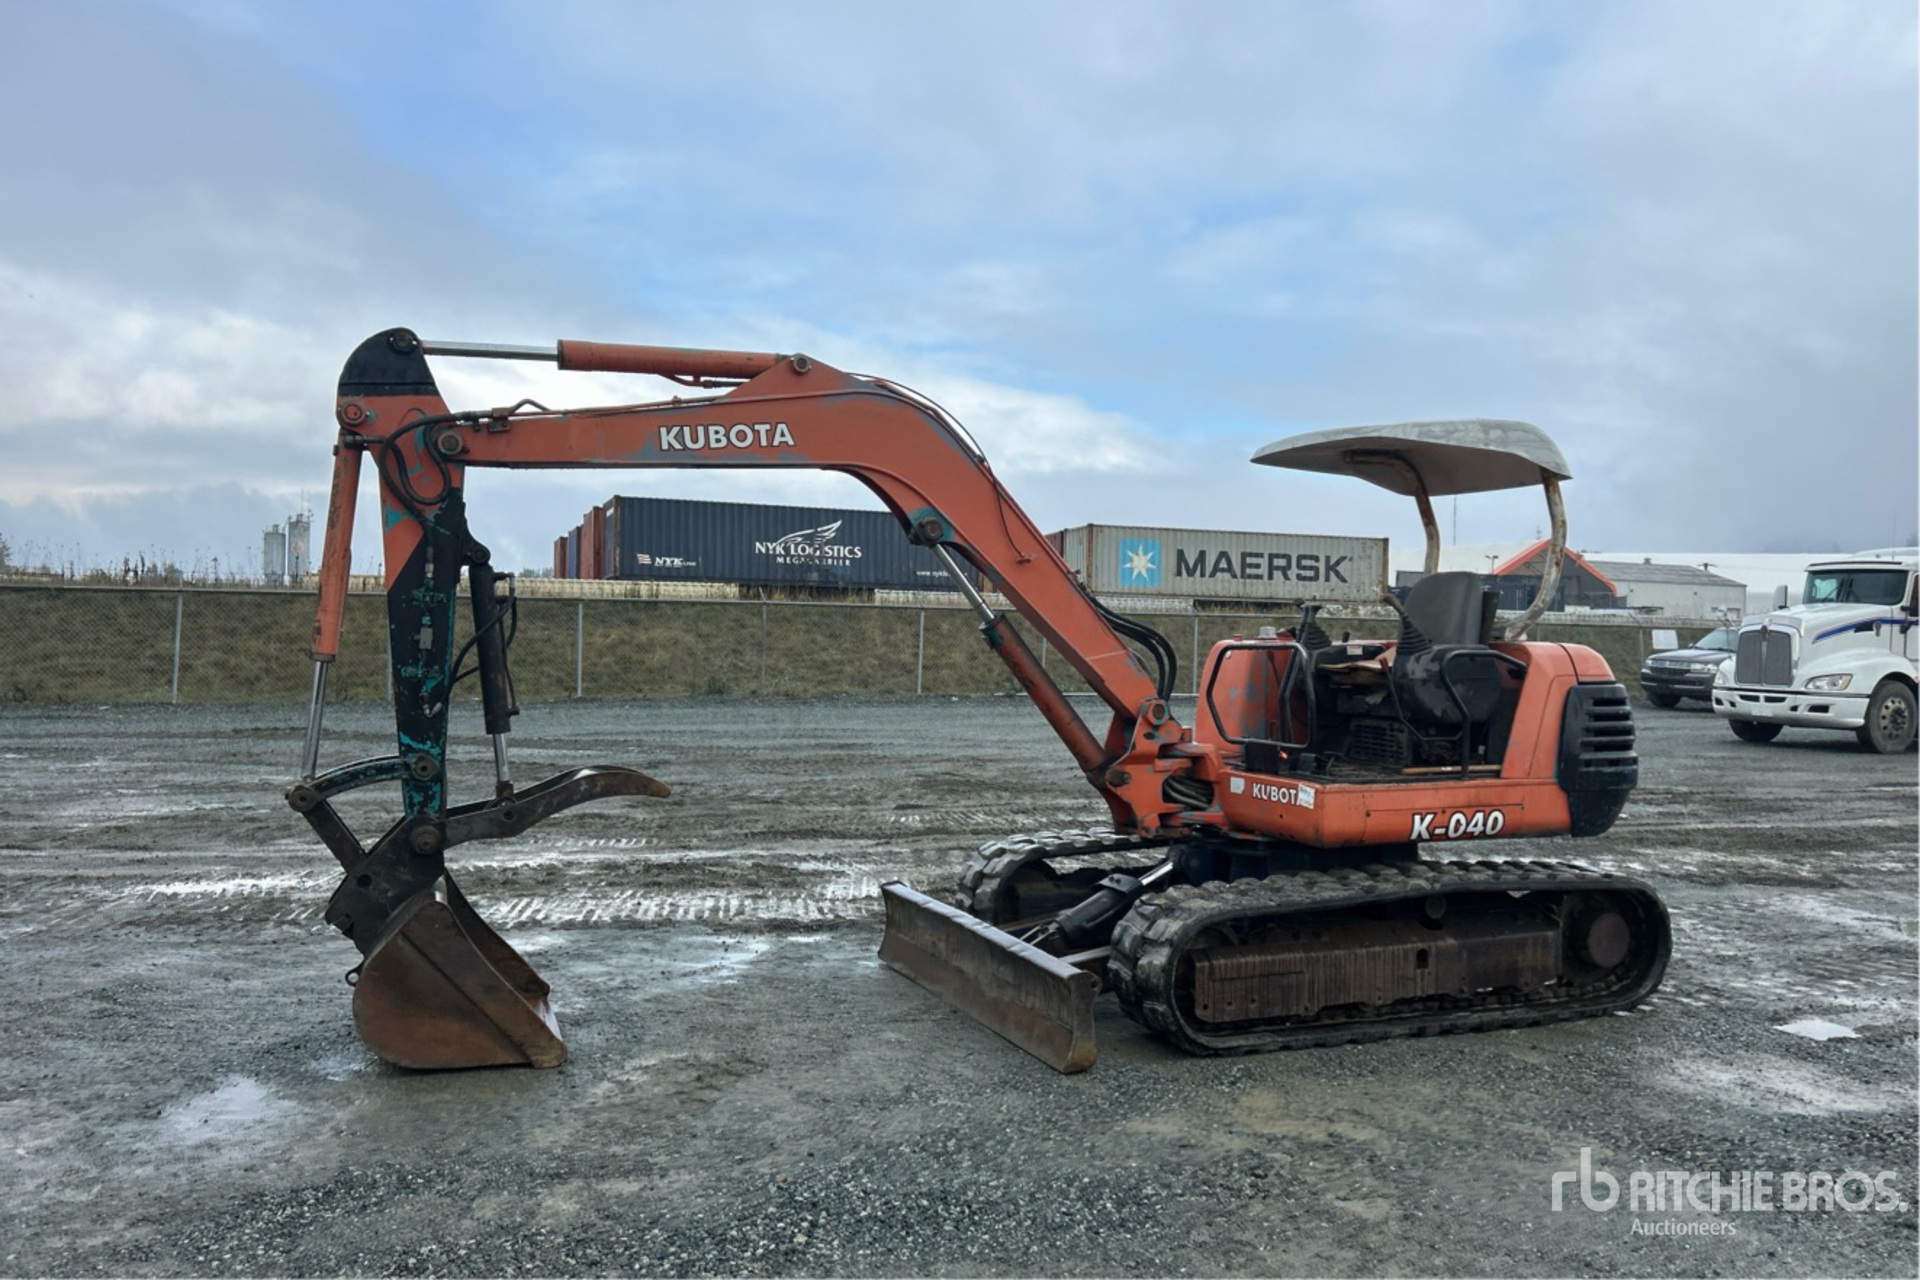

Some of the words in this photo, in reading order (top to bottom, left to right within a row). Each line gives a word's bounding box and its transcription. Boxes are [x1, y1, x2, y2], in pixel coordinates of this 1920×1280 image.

[659, 422, 796, 450] KUBOTA
[654, 556, 684, 568] NYK
[755, 541, 786, 555] NYK
[790, 543, 862, 558] LOGSTICS
[1176, 549, 1349, 583] MAERSK
[1409, 809, 1505, 841] K-040
